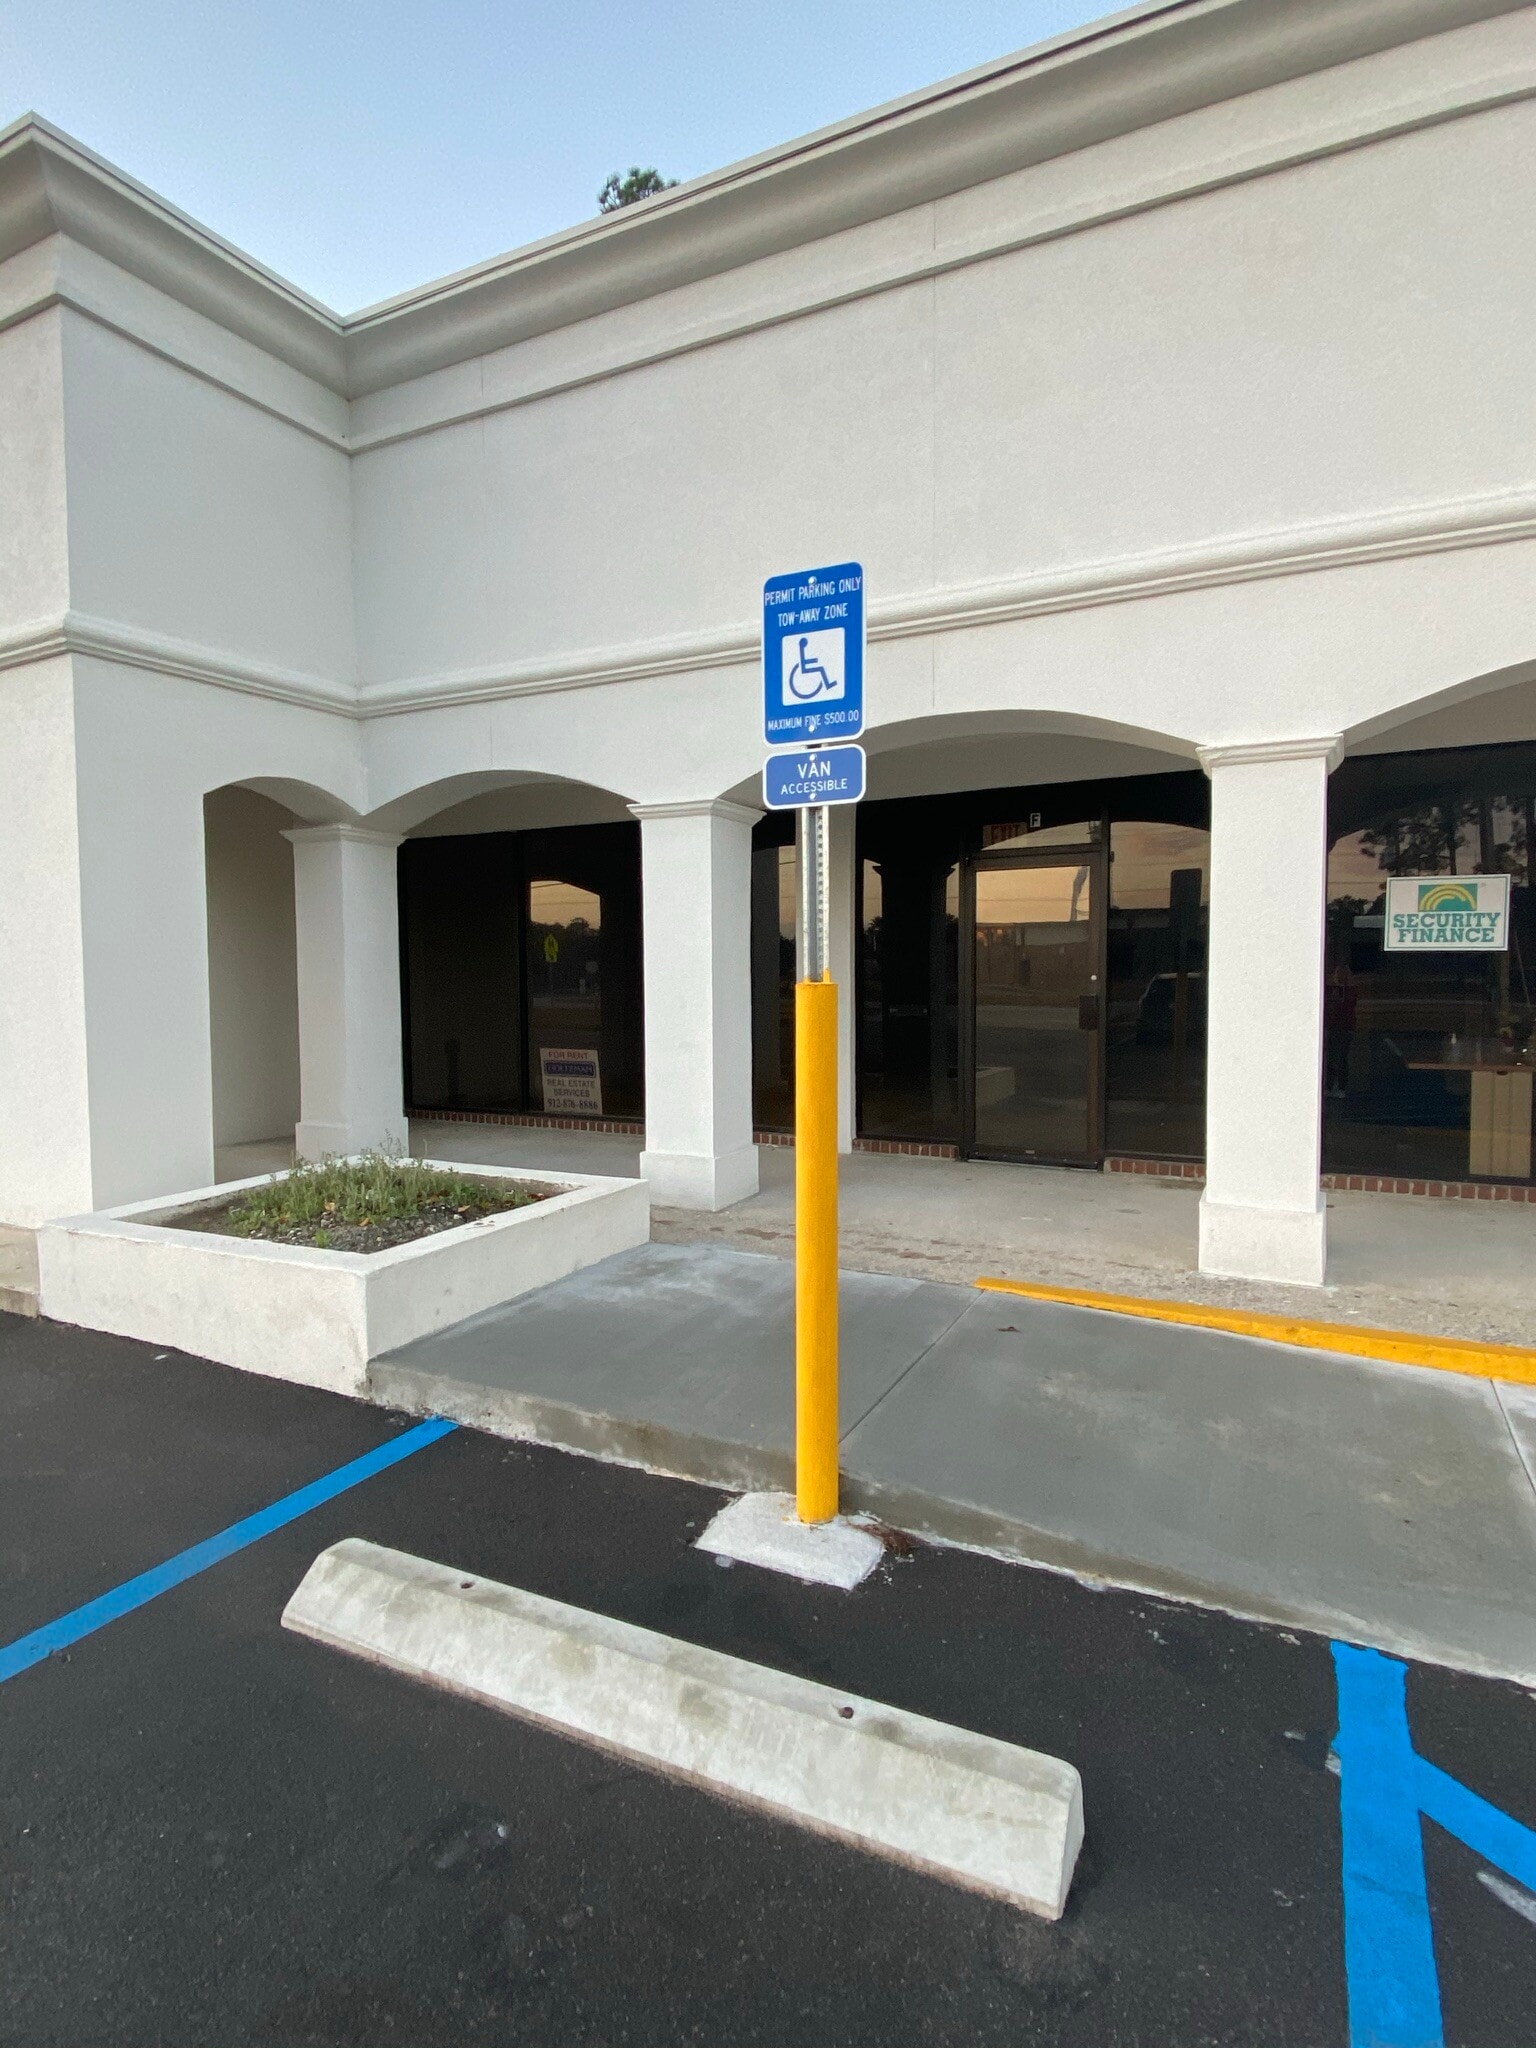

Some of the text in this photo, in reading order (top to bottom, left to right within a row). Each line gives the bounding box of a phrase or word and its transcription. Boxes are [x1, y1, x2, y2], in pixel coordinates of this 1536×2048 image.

[765, 575, 862, 607] PERMIT PARKING ONLY
[777, 602, 849, 628] TOW-AWAY ZONE
[767, 714, 802, 731] MAXIMUM
[804, 712, 822, 728] FINE
[797, 761, 831, 779] VAN
[780, 778, 848, 796] ACCESSIBLE
[991, 823, 1019, 845] EXIT
[1393, 912, 1501, 928] SECURITY
[1398, 927, 1495, 943] FINANCE
[548, 1051, 588, 1060] FOR RENT
[546, 1079, 596, 1089] REAL ESTATE
[553, 1088, 590, 1098] SERVICES
